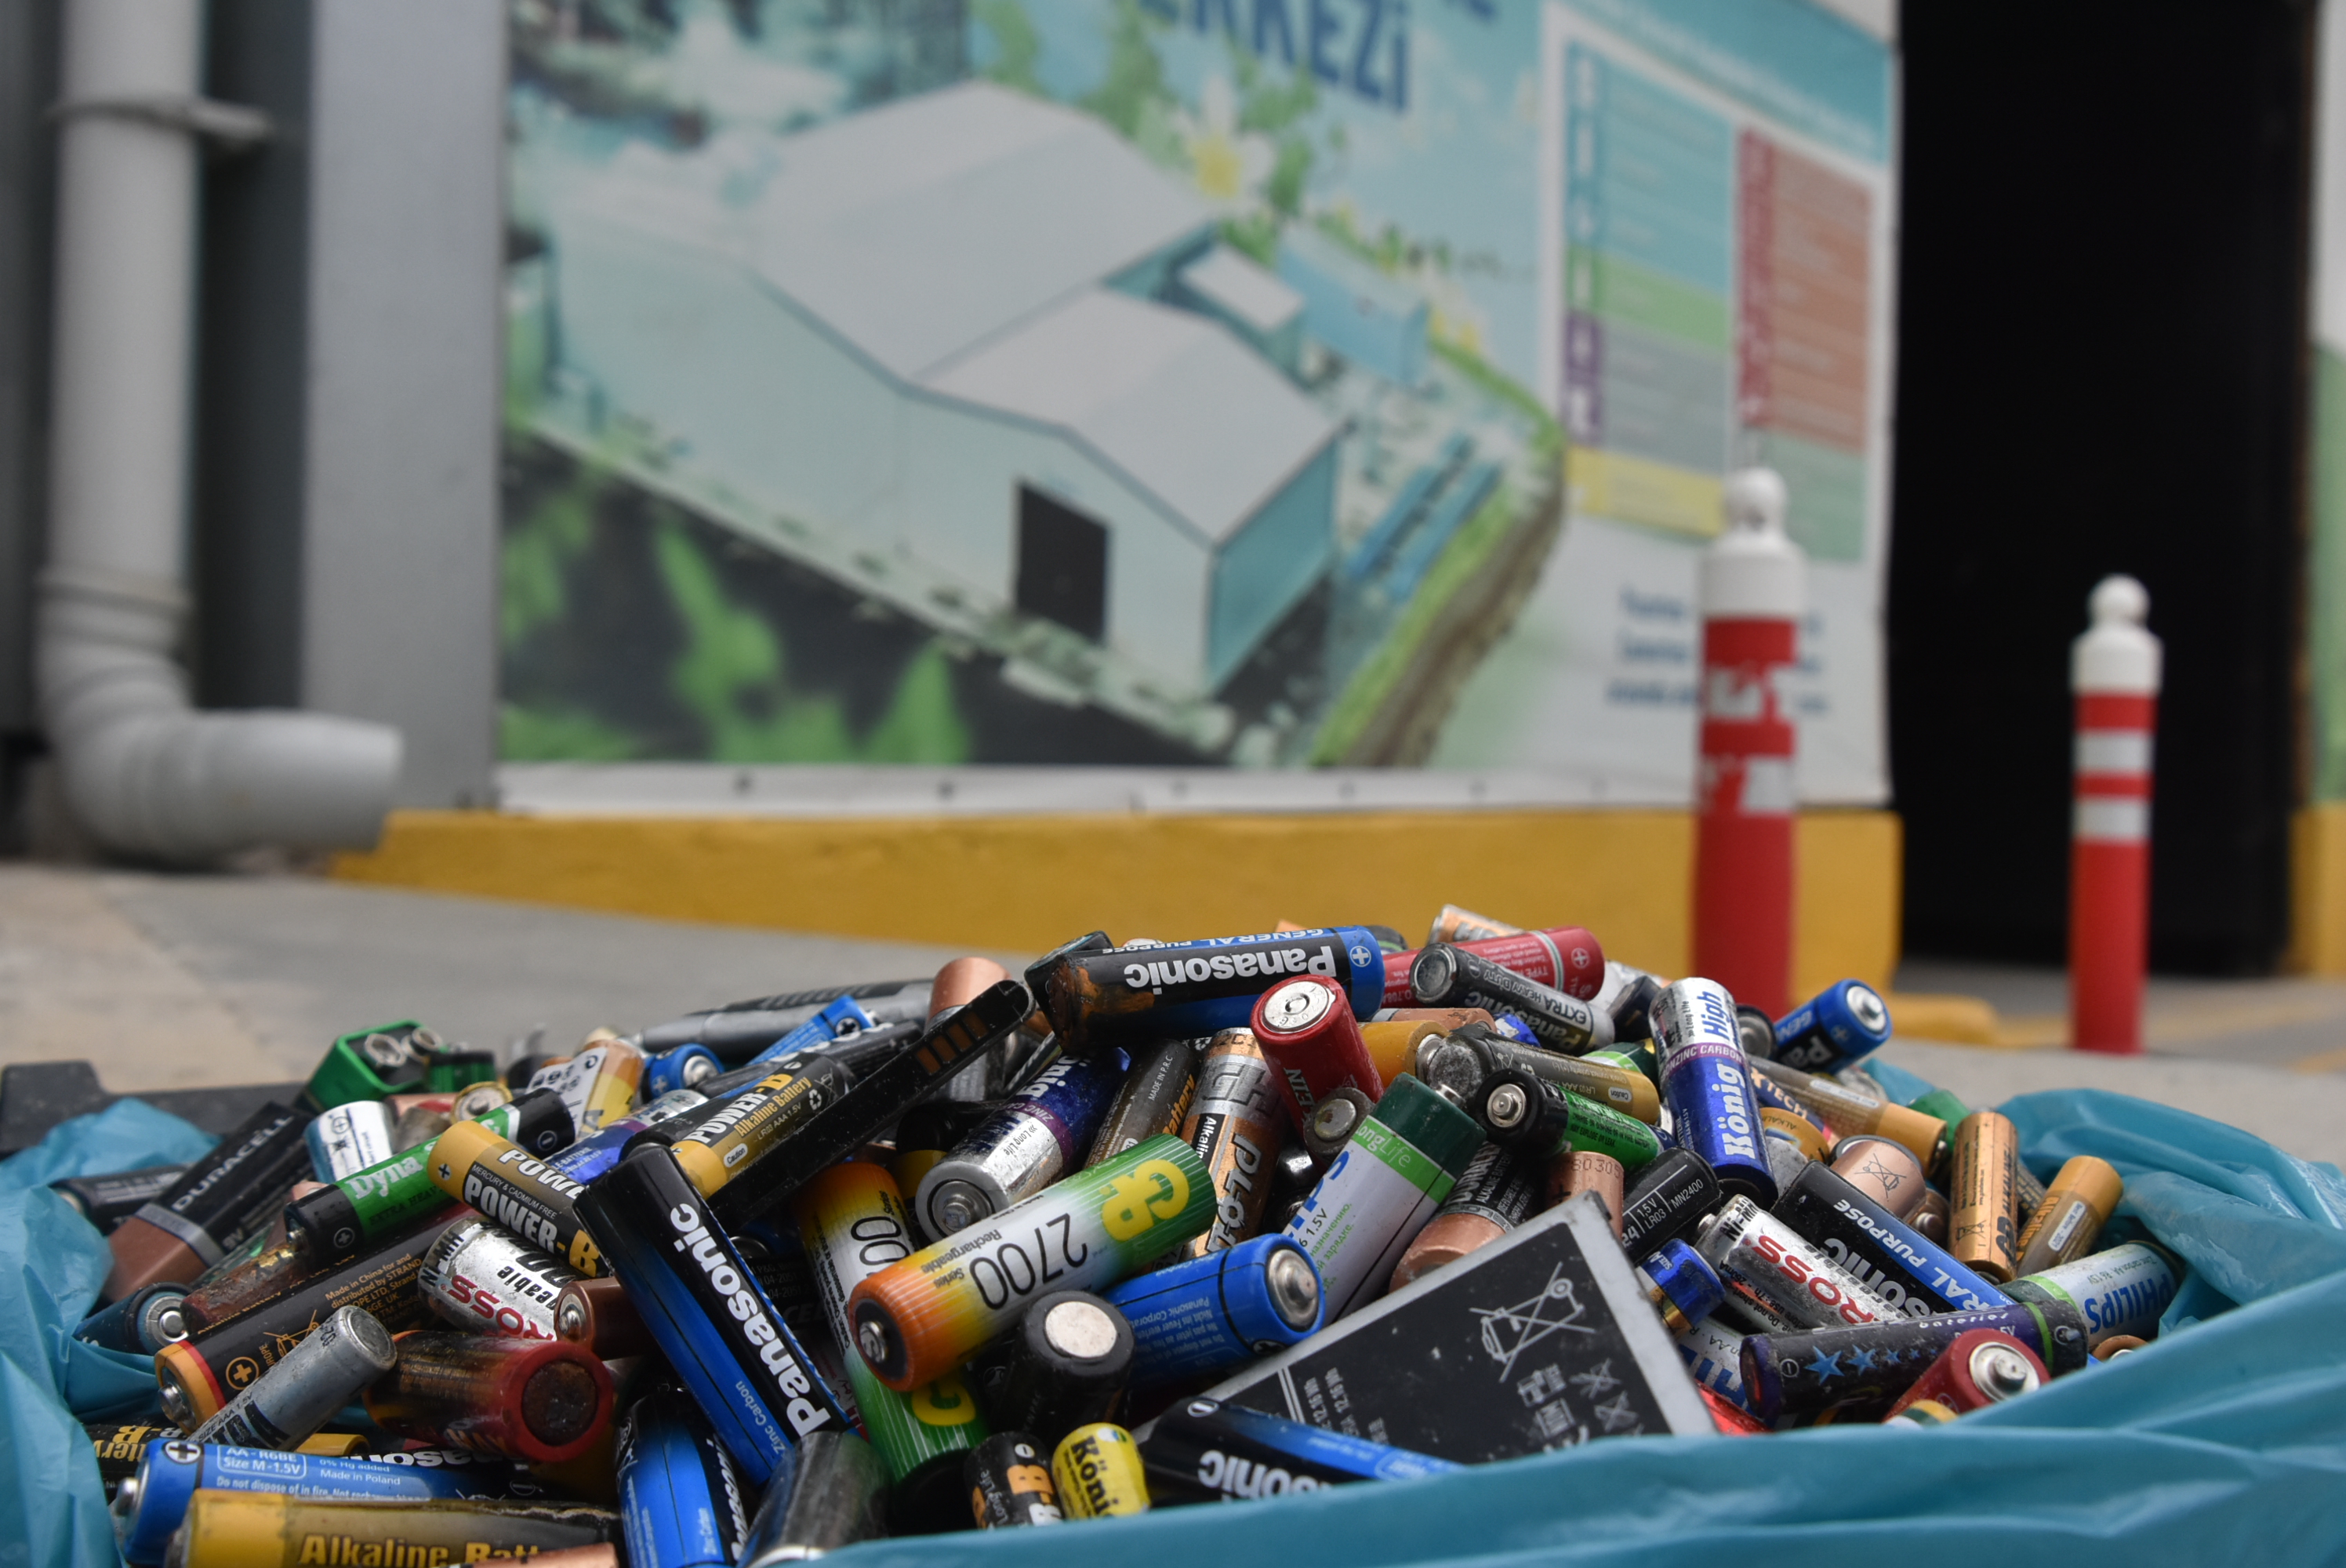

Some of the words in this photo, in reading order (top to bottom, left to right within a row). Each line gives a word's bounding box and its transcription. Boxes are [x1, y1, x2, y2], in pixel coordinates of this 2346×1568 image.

[1200, 928, 1324, 946] GENERAL
[1124, 946, 1338, 995] Panasonic
[1483, 967, 1512, 991] DUTY
[1511, 979, 1543, 1004] HEAVY
[1681, 999, 1690, 1014] Life
[1465, 991, 1583, 1052] Panasonic
[1544, 997, 1588, 1025] EXTRA
[1685, 1012, 1695, 1030] Long
[1697, 991, 1730, 1040] High
[1672, 1046, 1698, 1069] ZINC
[1700, 1044, 1744, 1065] CARBON
[1147, 1079, 1163, 1102] MADE
[1156, 1072, 1166, 1081] IN
[684, 1073, 794, 1144] POWER-B
[733, 1102, 777, 1138] Alkaline
[772, 1076, 813, 1110] Battery
[771, 1112, 790, 1128] AAA
[786, 1101, 804, 1117] 1.5V
[1025, 1102, 1055, 1123] ZINC
[1714, 1060, 1757, 1161] König
[1001, 1141, 1019, 1157] Life
[1012, 1129, 1032, 1147] Long
[1196, 1116, 1217, 1161] Alkalin
[170, 1114, 295, 1212] DURACELL
[724, 1146, 747, 1165] Caution
[344, 1154, 424, 1200] Dyna
[472, 1163, 504, 1189] MERCURY
[502, 1182, 510, 1193] &
[508, 1186, 540, 1210] CADMIUM
[538, 1201, 558, 1220] FREE
[1670, 1178, 1705, 1210] MN2400
[463, 1174, 601, 1279] POWER-B
[1302, 1207, 1332, 1238] 1.5V
[1644, 1208, 1668, 1231] LR03
[1833, 1199, 1927, 1272] PURPOSE
[850, 1216, 911, 1267] 00
[921, 1229, 1002, 1275] Rechargeable
[324, 1283, 351, 1301] Made
[348, 1278, 360, 1289] in
[358, 1266, 384, 1284] China
[382, 1261, 396, 1272] for
[394, 1252, 412, 1266] and
[934, 1265, 965, 1290] Series
[969, 1213, 1088, 1310] 2700
[1820, 1236, 1931, 1316] sonic
[329, 1282, 377, 1310] distributed
[375, 1276, 389, 1290] by
[385, 1258, 424, 1282] STRAND
[369, 1285, 391, 1301] LTD,
[389, 1271, 418, 1290] Strand
[1752, 1235, 1879, 1325] ROSS
[446, 1275, 554, 1341] ROSS
[670, 1202, 832, 1438] Panasonic
[1129, 1308, 1168, 1330] Corporat
[1167, 1296, 1211, 1318] Panasonic
[2083, 1273, 2177, 1334] PHILIPS
[259, 1344, 277, 1369] UROPE
[198, 1424, 217, 1443] SIZE
[216, 1409, 235, 1428] AAA
[235, 1392, 253, 1411] 1.5V
[735, 1379, 767, 1428] Carbon
[764, 1425, 788, 1454] Zinc
[223, 1456, 250, 1471] Size
[320, 1469, 345, 1481] Made
[352, 1471, 363, 1482] in
[365, 1472, 401, 1486] Poland
[358, 1464, 391, 1473] added
[1070, 1435, 1122, 1518] Köni
[216, 1475, 231, 1487] Do
[231, 1478, 249, 1489] not
[251, 1479, 288, 1494] dispose
[288, 1483, 300, 1494] of
[989, 1490, 1010, 1525] Long
[299, 1534, 451, 1568] Alkaline
